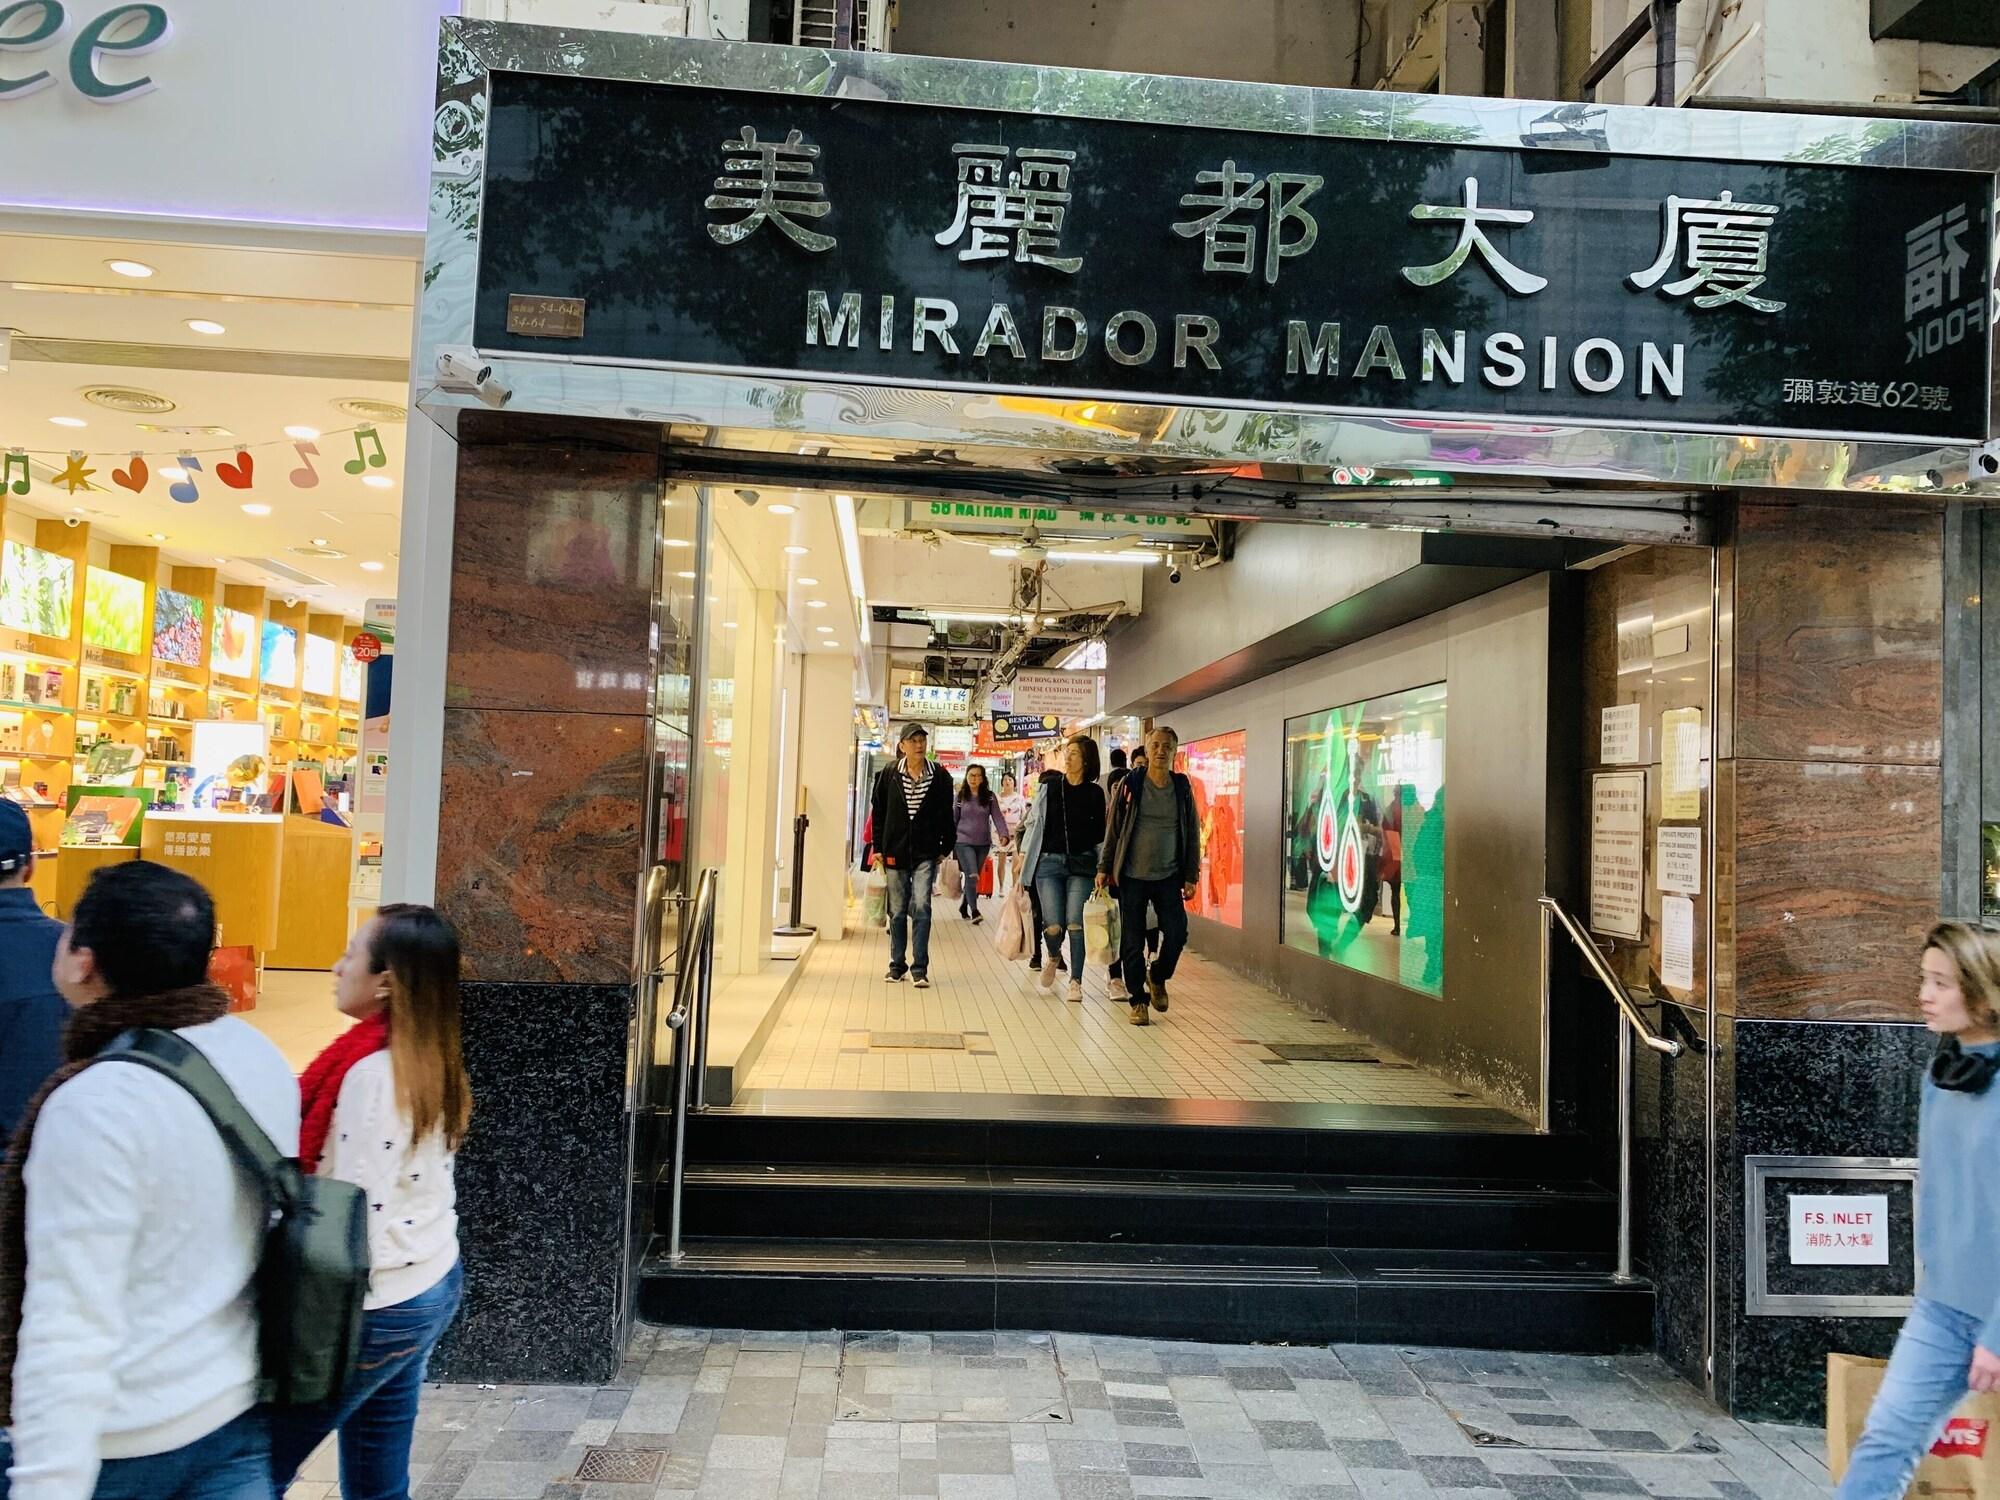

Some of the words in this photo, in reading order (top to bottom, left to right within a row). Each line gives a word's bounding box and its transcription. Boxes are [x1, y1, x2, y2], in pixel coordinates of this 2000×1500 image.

[705, 125, 1787, 312] 美麗都大廈
[806, 290, 1222, 371] MIRADOR
[1287, 321, 1685, 398] MANSION
[1783, 378, 1952, 411] 彌敦道62號
[903, 700, 966, 712] SATELLITES
[1008, 715, 1042, 723] BESPOKE
[1012, 723, 1040, 731] TAILOR
[1805, 1212, 1828, 1225] F.S.
[1833, 1212, 1873, 1225] INLET
